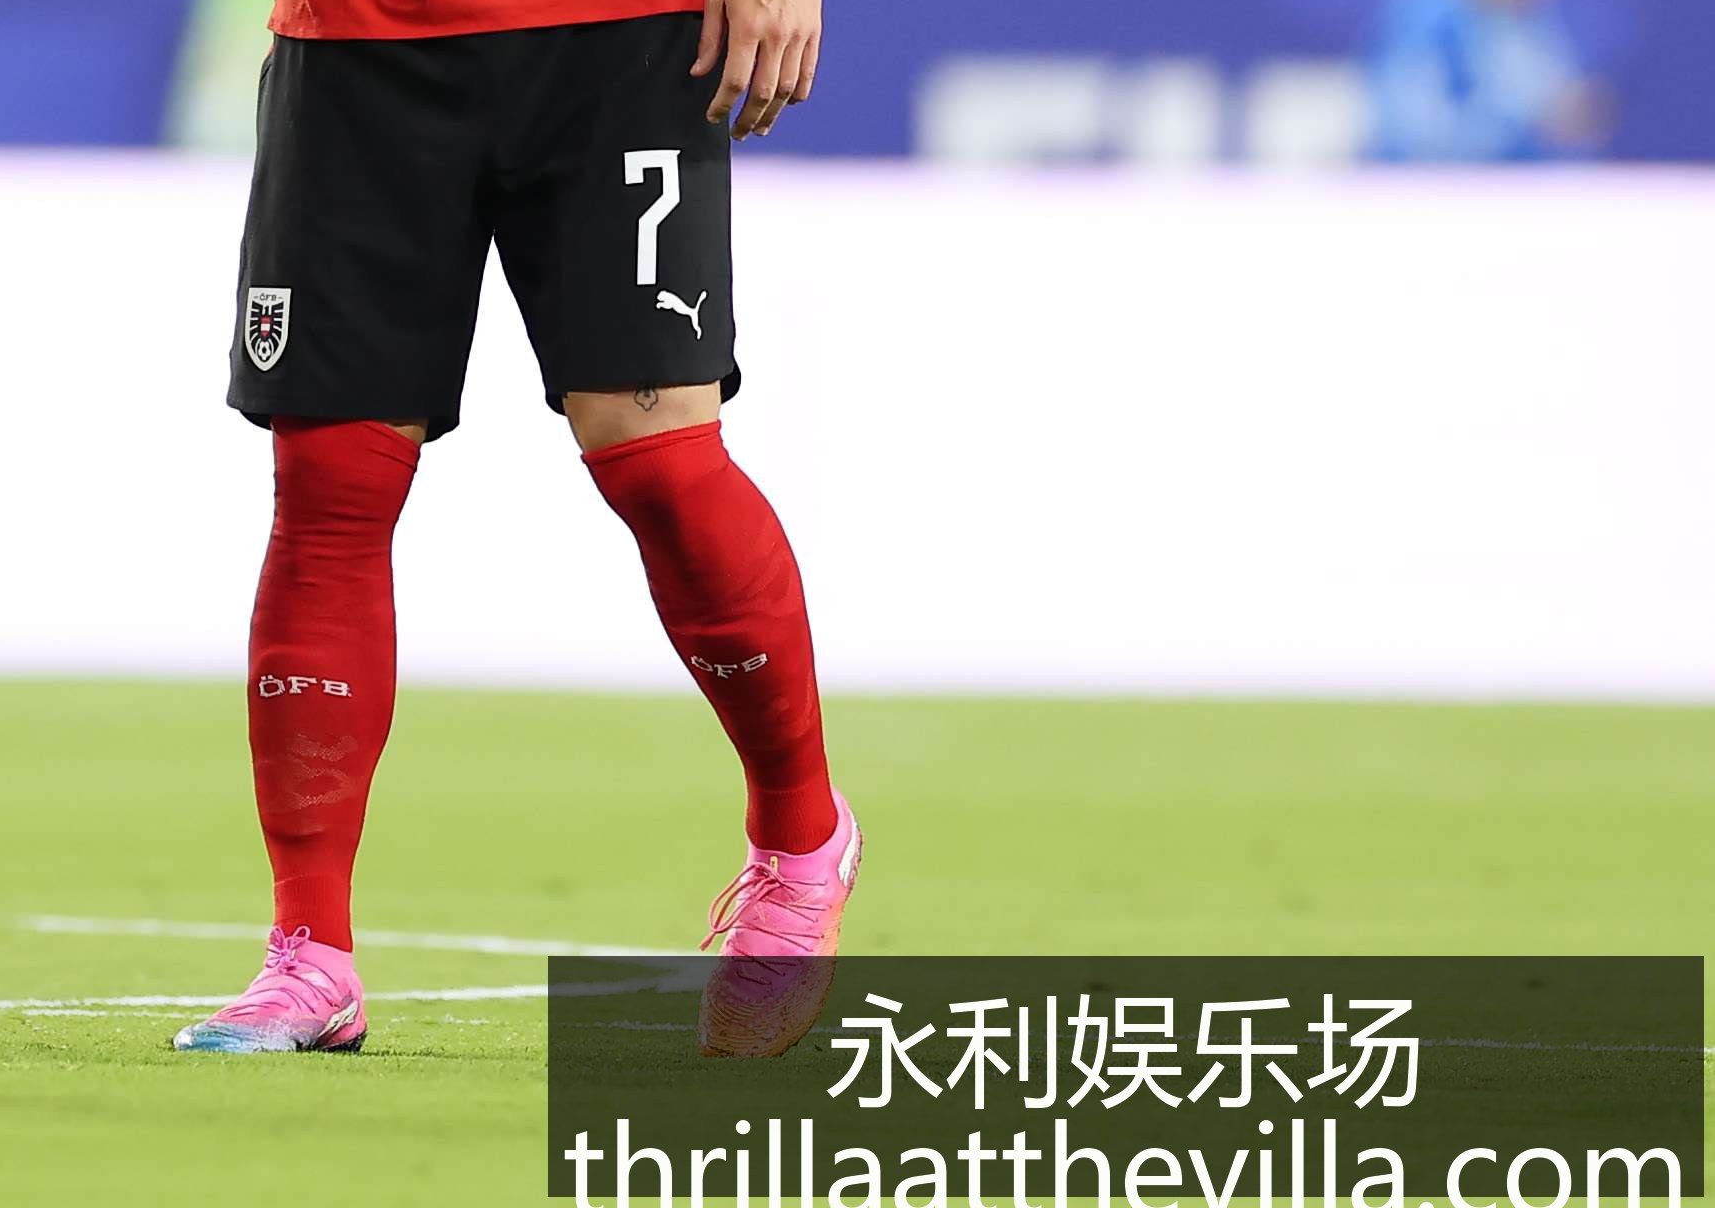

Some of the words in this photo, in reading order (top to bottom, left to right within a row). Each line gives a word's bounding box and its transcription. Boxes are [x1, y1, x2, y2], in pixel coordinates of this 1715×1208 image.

[624, 148, 681, 285] 7
[690, 652, 768, 680] ÖFB
[258, 674, 351, 698] ÖFB
